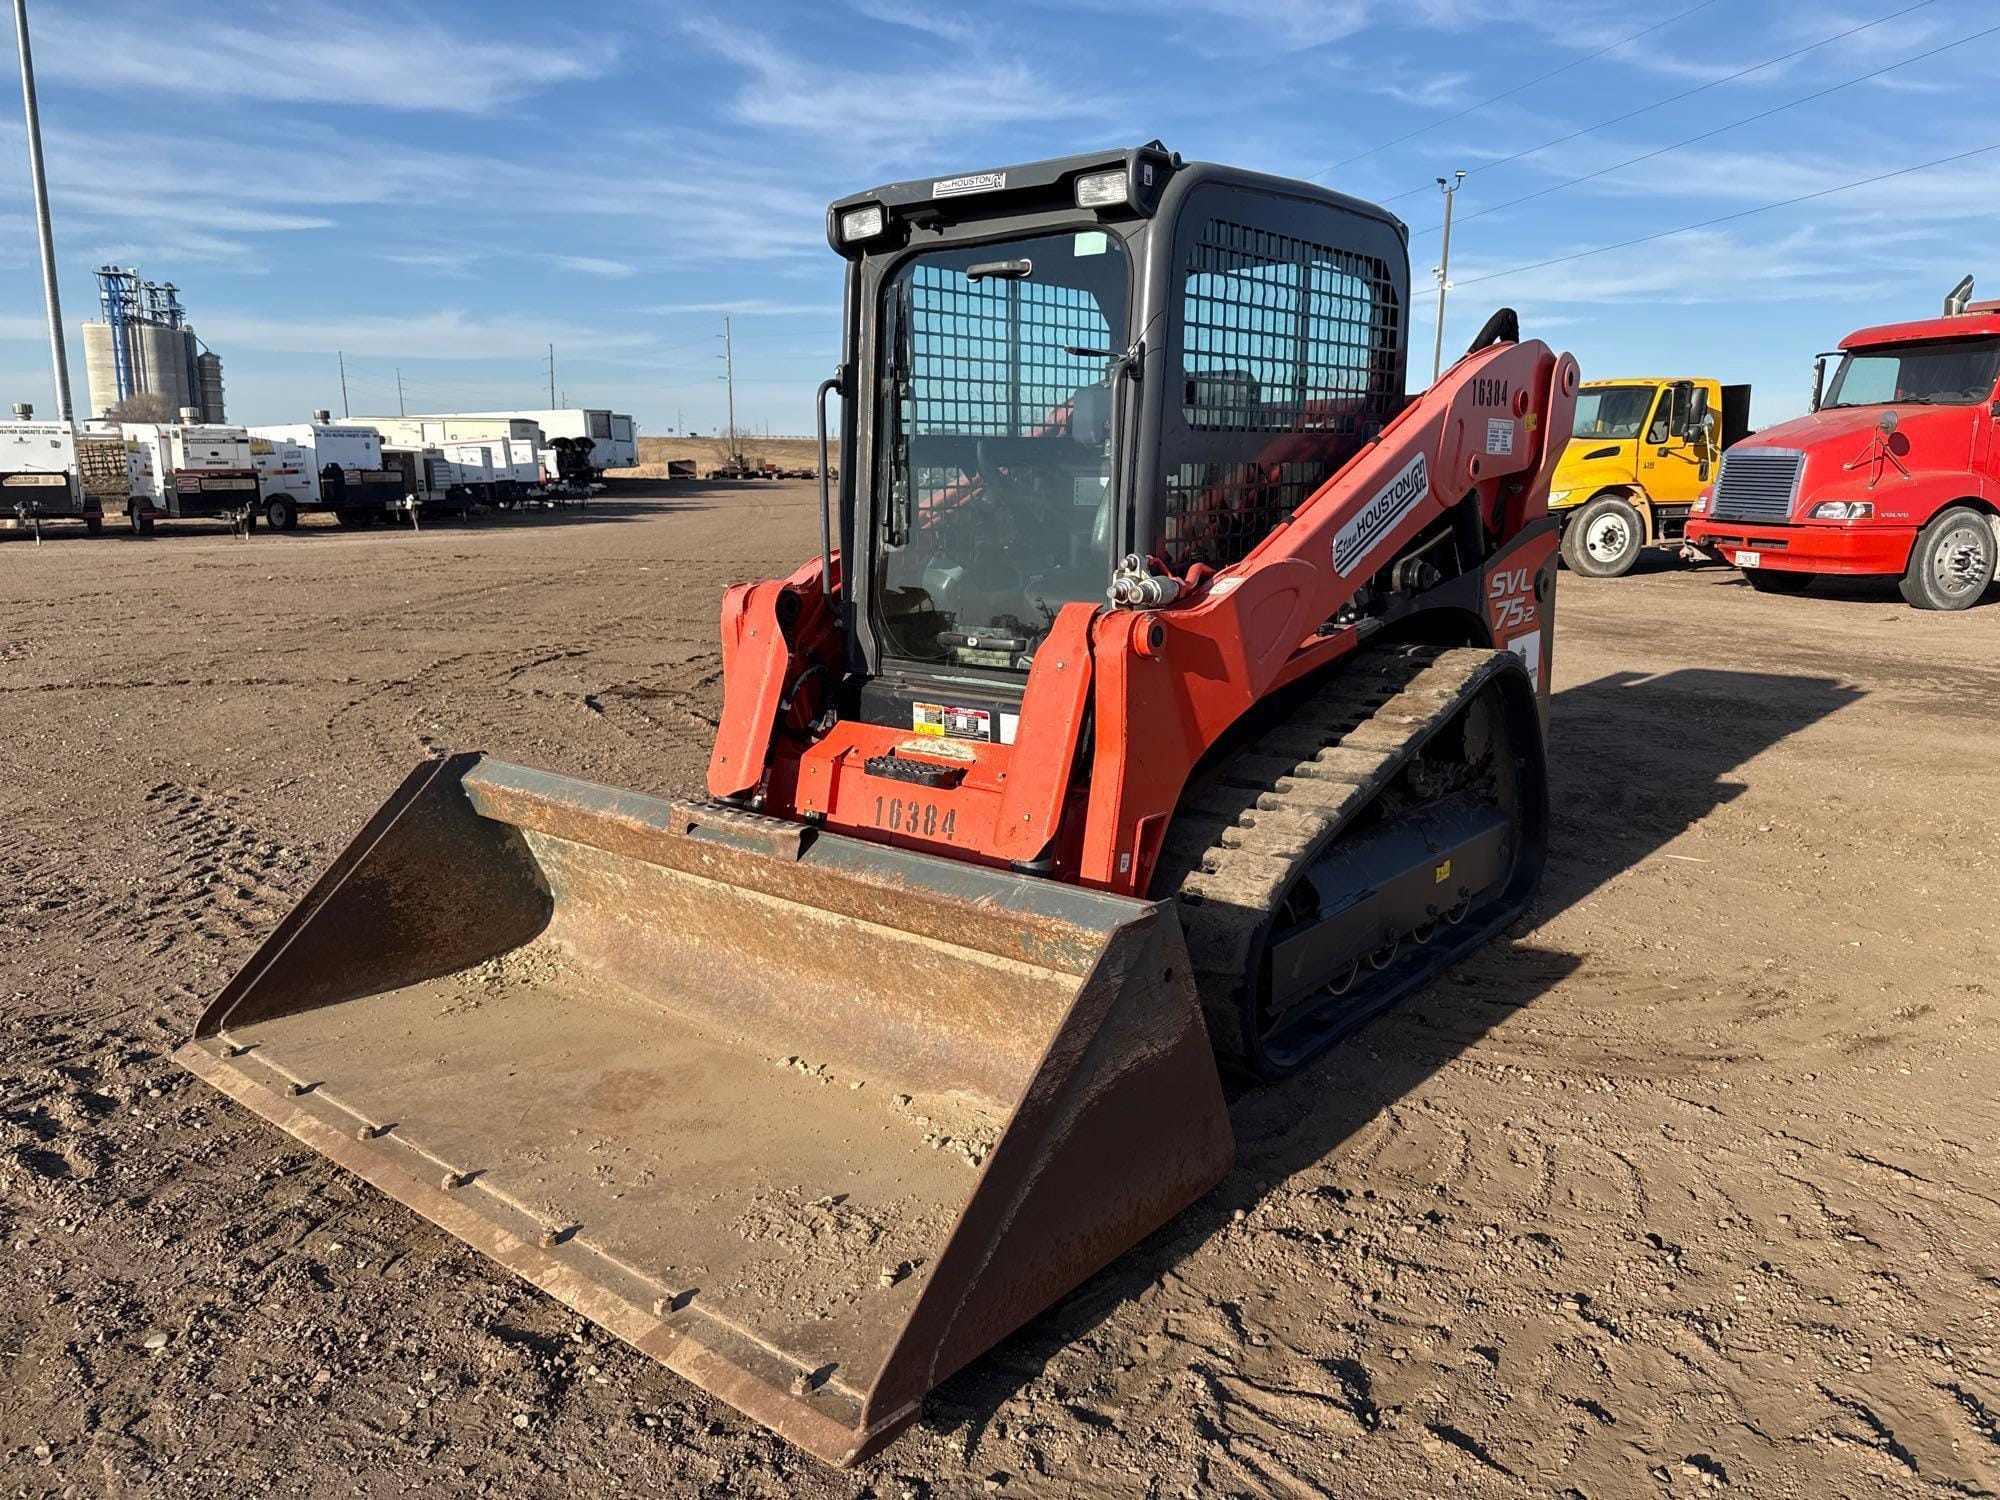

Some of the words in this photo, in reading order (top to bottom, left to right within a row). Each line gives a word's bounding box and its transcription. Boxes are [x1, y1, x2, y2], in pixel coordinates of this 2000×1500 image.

[951, 175, 991, 188] HOUSTON
[1472, 378, 1508, 407] 16384
[1335, 532, 1358, 563] Stan
[1357, 474, 1411, 539] HOUSTON
[1489, 567, 1533, 599] SVL
[875, 795, 956, 840] 16384
